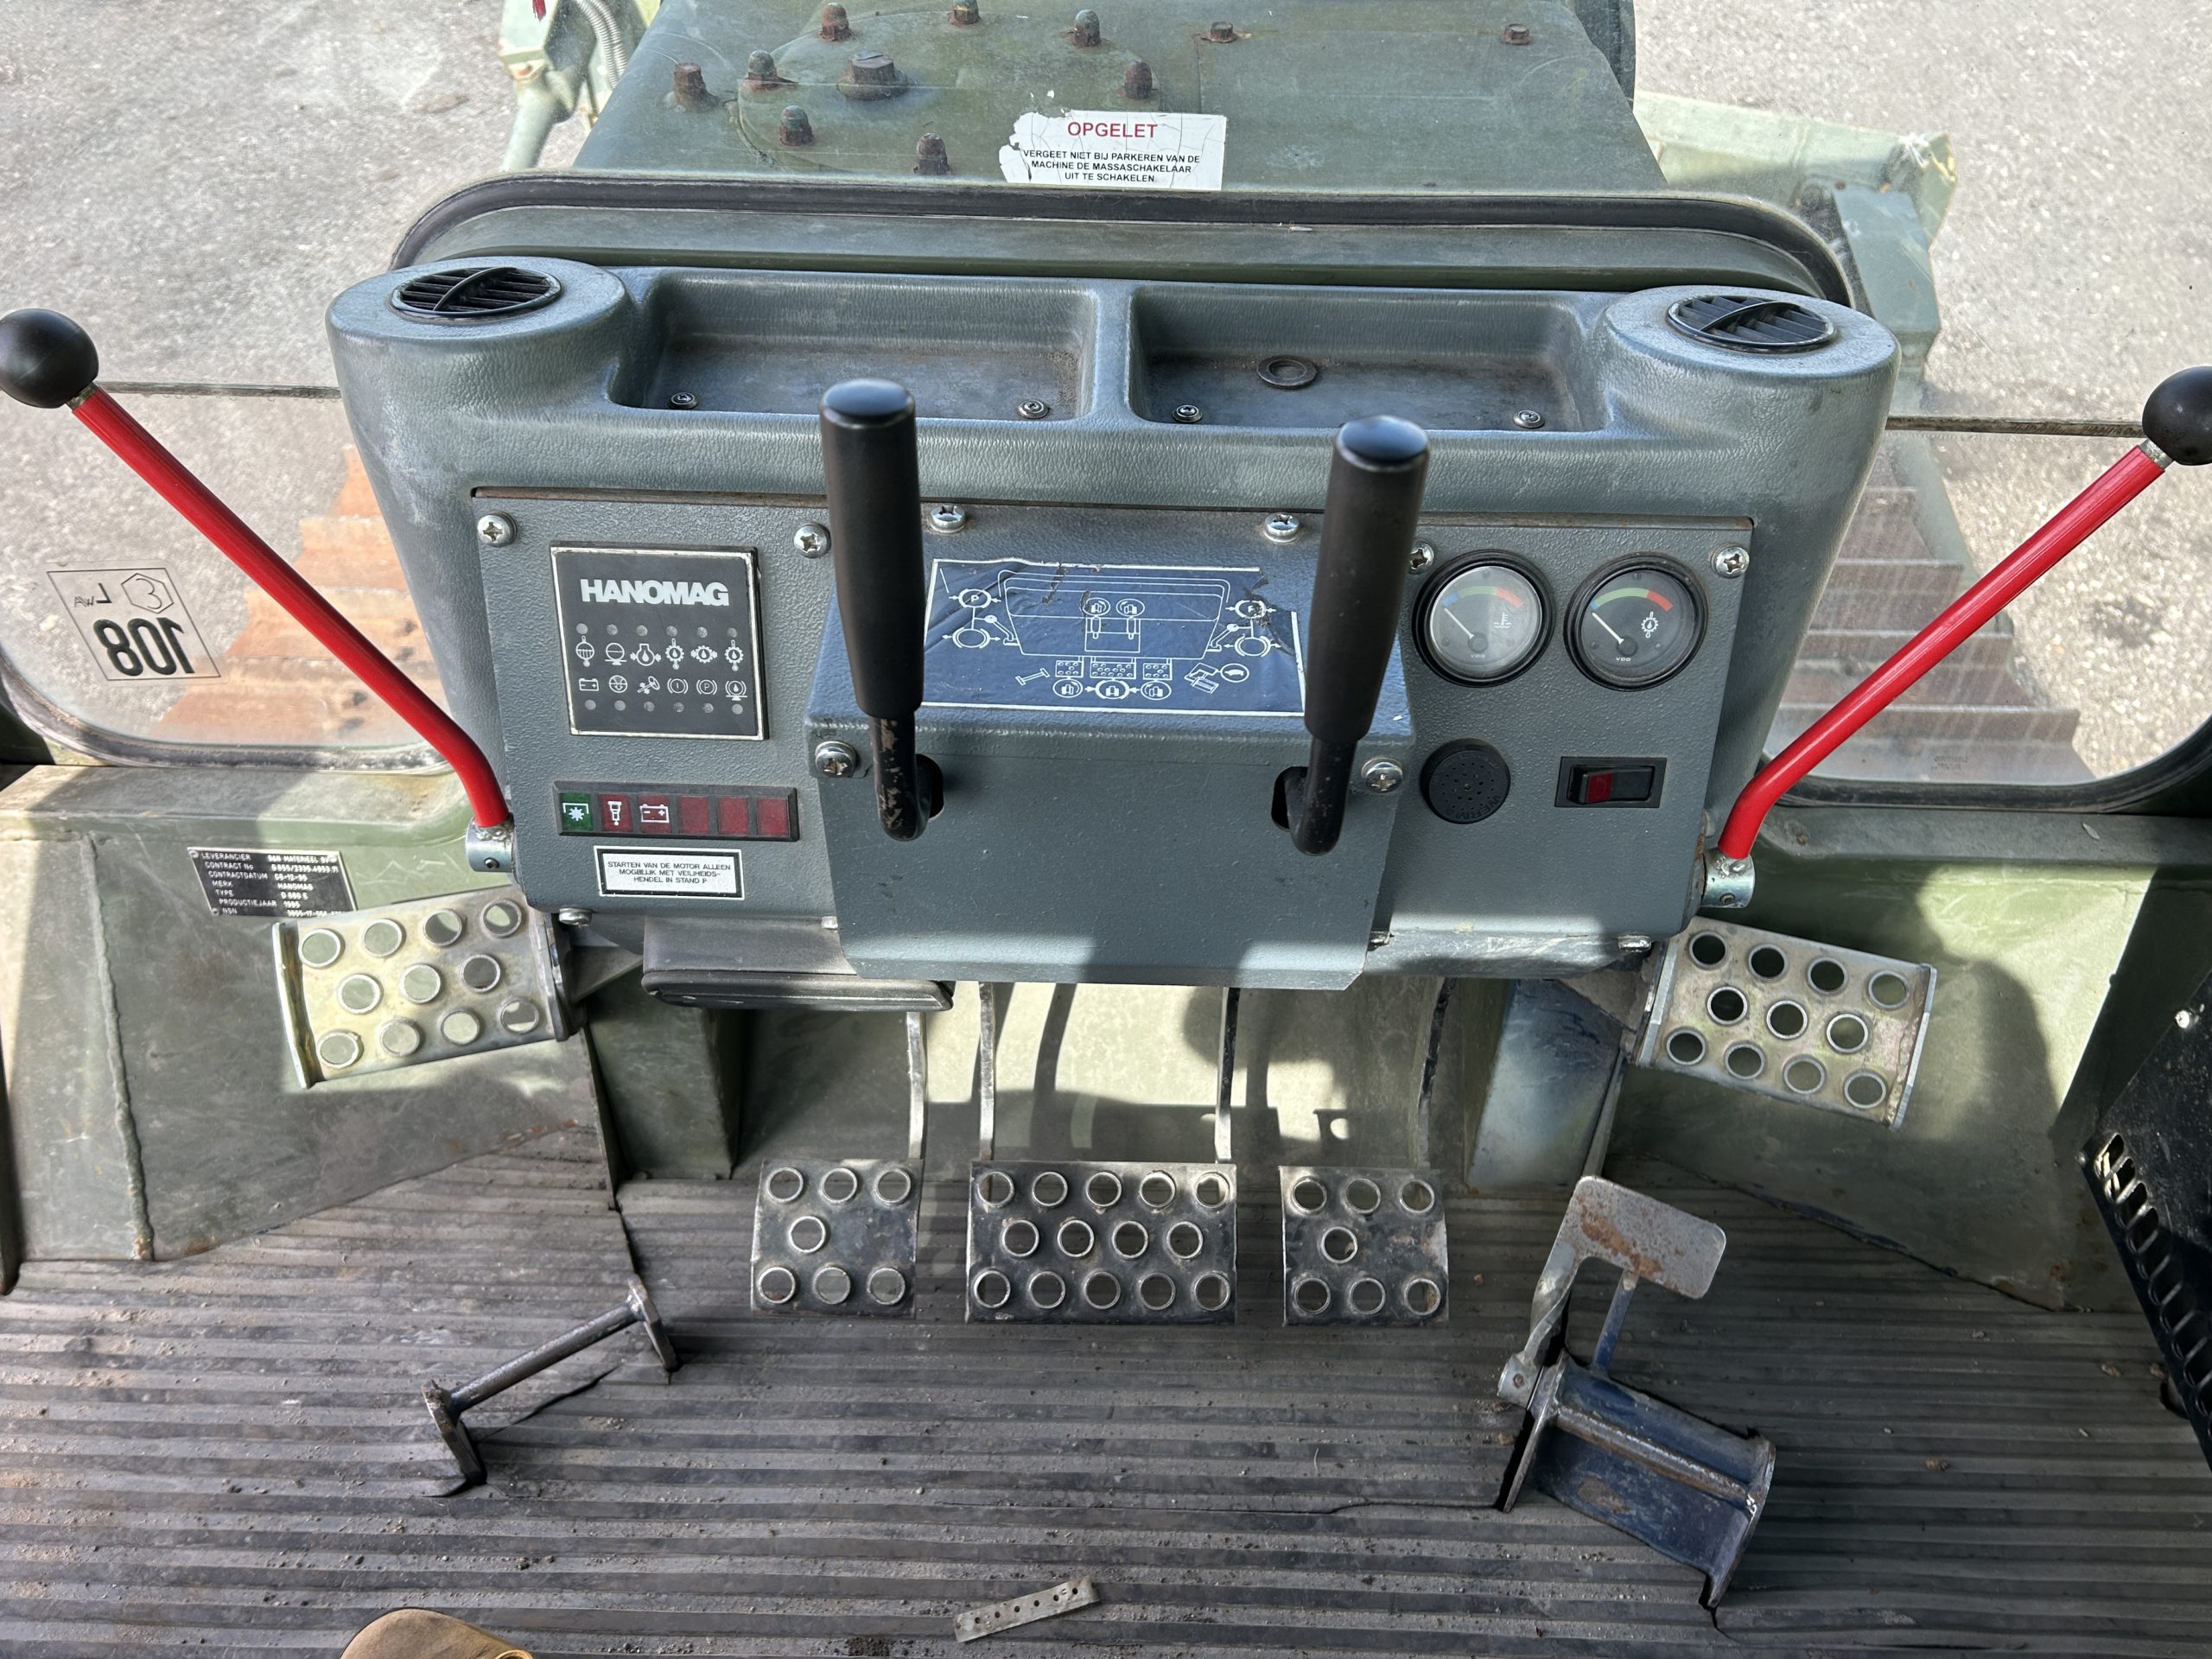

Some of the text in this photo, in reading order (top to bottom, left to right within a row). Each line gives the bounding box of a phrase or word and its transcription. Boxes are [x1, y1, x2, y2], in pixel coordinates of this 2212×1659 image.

[1068, 122, 1158, 138] OPGELET
[1023, 149, 1200, 163] VERGEET NIET BIJ PARKEREN VAN DE
[1032, 161, 1191, 173] MACHINE DE MASSASCHAKELAAR
[581, 579, 729, 607] HANOMAG
[202, 852, 251, 861] LEVERANCIER
[205, 861, 242, 870] CONTRACT
[208, 871, 268, 880] CONTRACTDATUM
[213, 880, 314, 892] MERK HANOMAG
[214, 888, 234, 897] TYPE
[219, 899, 277, 907] PRODUCTIEJAAR
